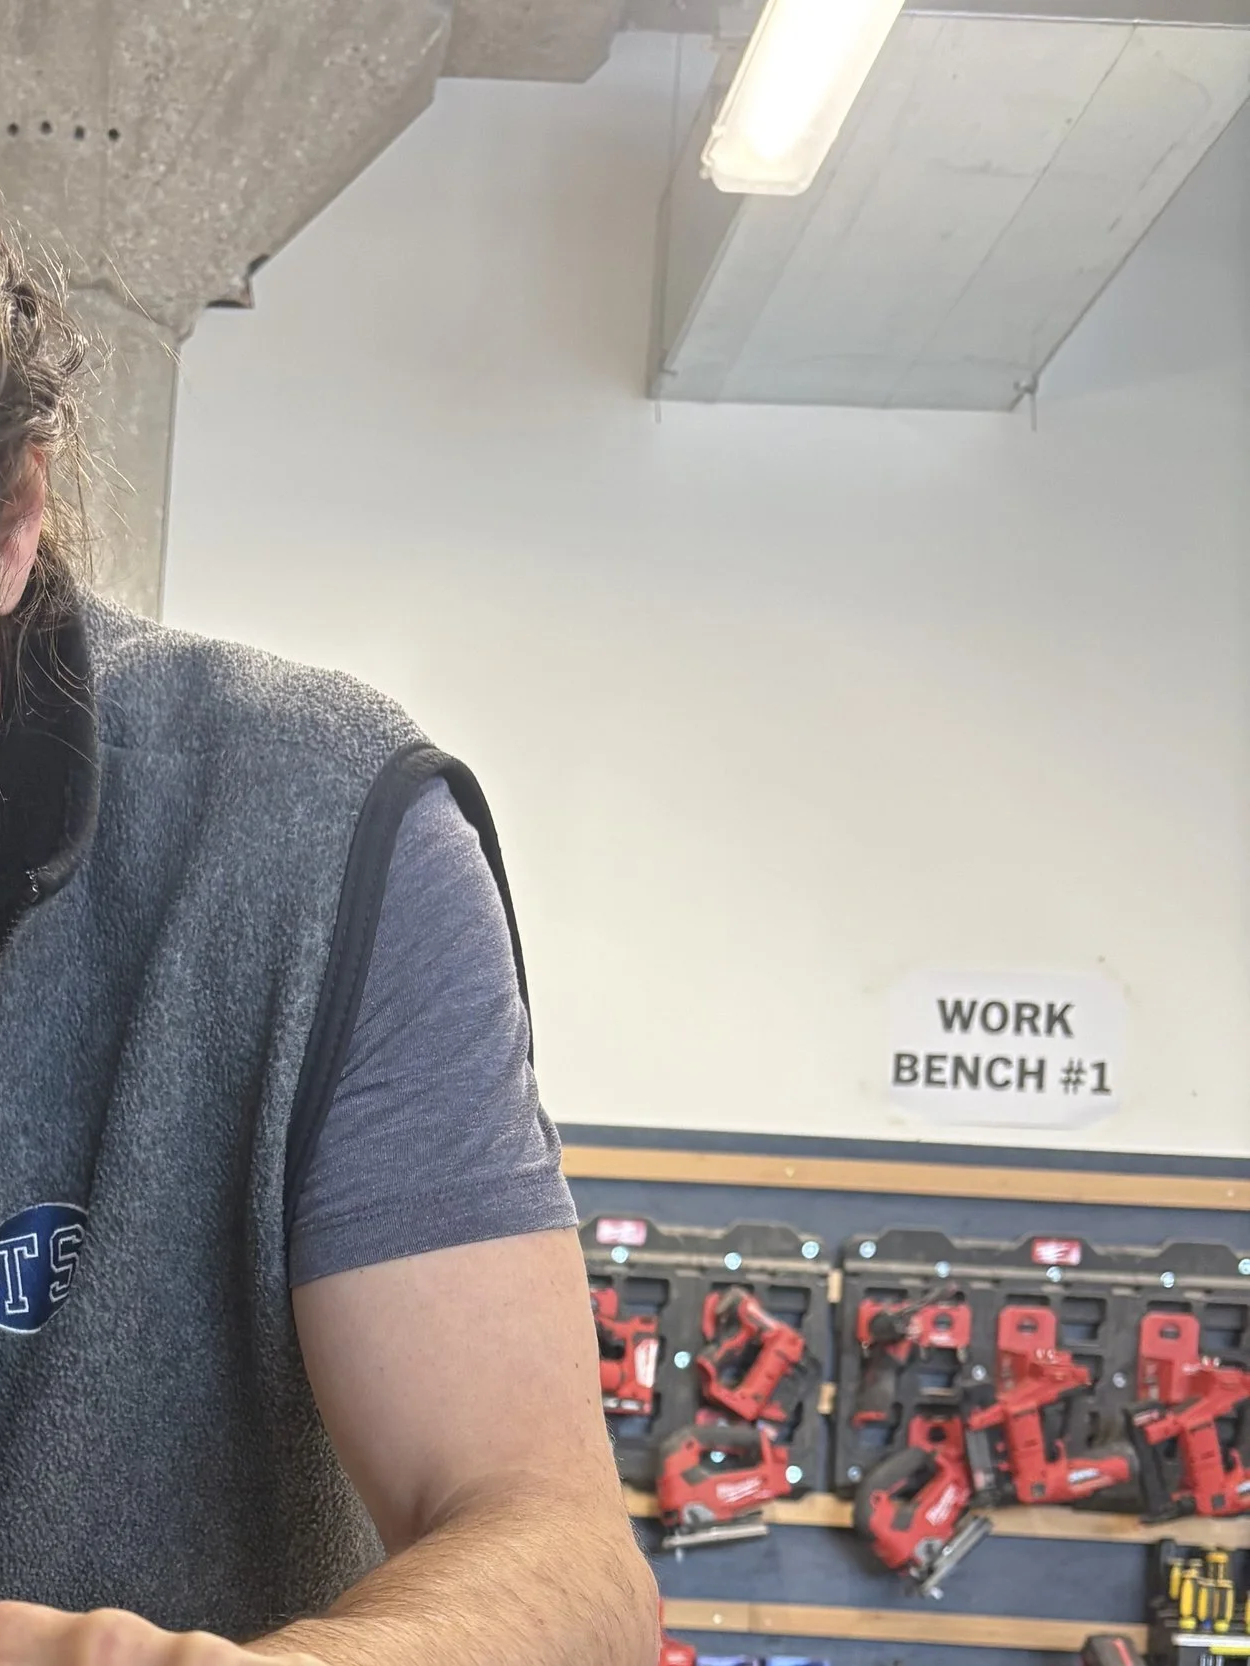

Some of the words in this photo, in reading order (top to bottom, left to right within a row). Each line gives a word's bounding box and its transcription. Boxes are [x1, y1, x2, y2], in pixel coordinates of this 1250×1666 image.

[937, 998, 1075, 1038] WORK
[892, 1052, 1046, 1093] BENCH
[1059, 1058, 1112, 1096] #1
